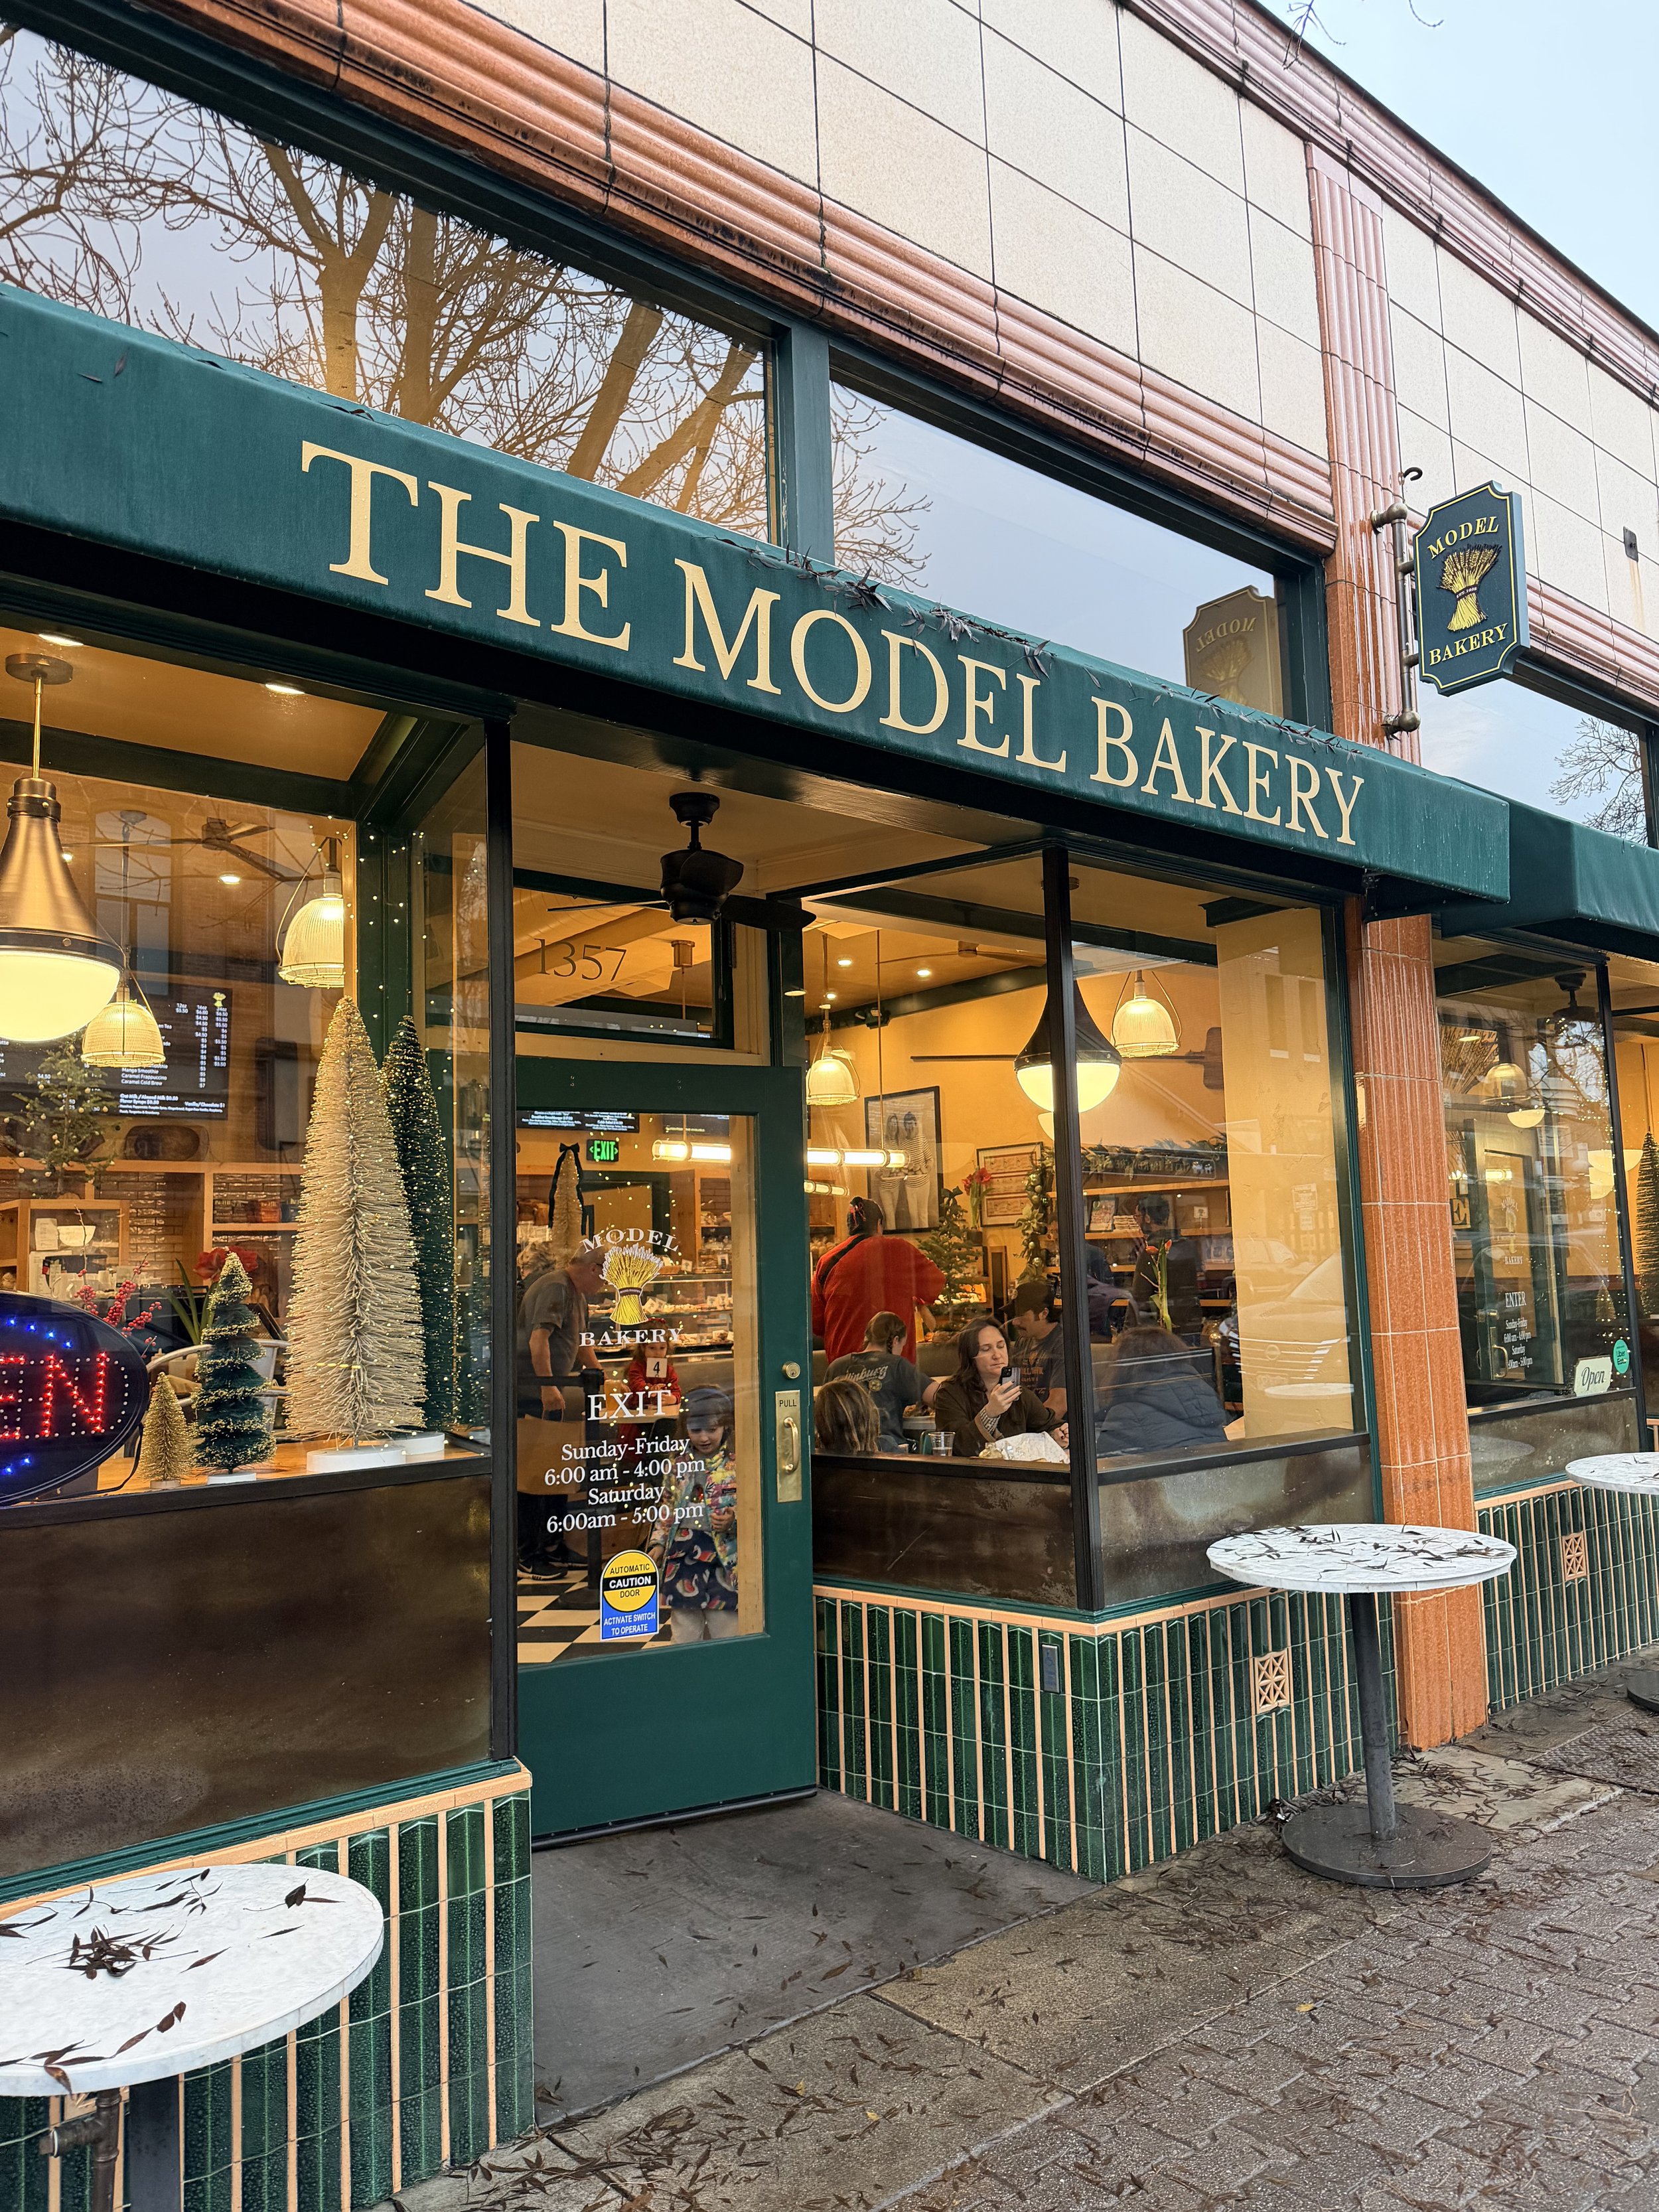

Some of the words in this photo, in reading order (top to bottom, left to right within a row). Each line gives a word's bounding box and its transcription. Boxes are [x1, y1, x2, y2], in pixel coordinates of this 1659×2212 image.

[1427, 516, 1500, 560] MODEL
[301, 440, 631, 652] THE
[672, 558, 1066, 773] MODEL
[1090, 696, 1364, 846] BAKERY
[1429, 623, 1508, 666] BAKERY
[534, 938, 627, 982] 1357
[594, 1140, 616, 1161] EXIT
[579, 1228, 680, 1254] MODEL
[1505, 1291, 1526, 1308] ENTER
[579, 1328, 684, 1347] BAKERY
[652, 1361, 661, 1374] 4
[1581, 1366, 1605, 1391] Open
[587, 1390, 672, 1422] EXIT
[779, 1399, 797, 1408] PULL
[561, 1435, 691, 1461] Sunday-Friday
[545, 1466, 585, 1486] 6:00
[590, 1466, 618, 1482] am
[634, 1459, 672, 1478] 4:00
[676, 1459, 705, 1479] pm
[588, 1483, 666, 1506] Saturday
[547, 1512, 616, 1534] 6:00am
[632, 1505, 670, 1524] 5:00
[673, 1505, 703, 1525] pm
[610, 1563, 650, 1575] AUTOMATIC
[609, 1575, 652, 1589] CAUTION
[620, 1589, 640, 1599] DOOR
[603, 1614, 632, 1627] ACTIVATE
[633, 1611, 656, 1623] SWITCH
[611, 1627, 620, 1636] TO
[620, 1623, 648, 1635] OPERATE
